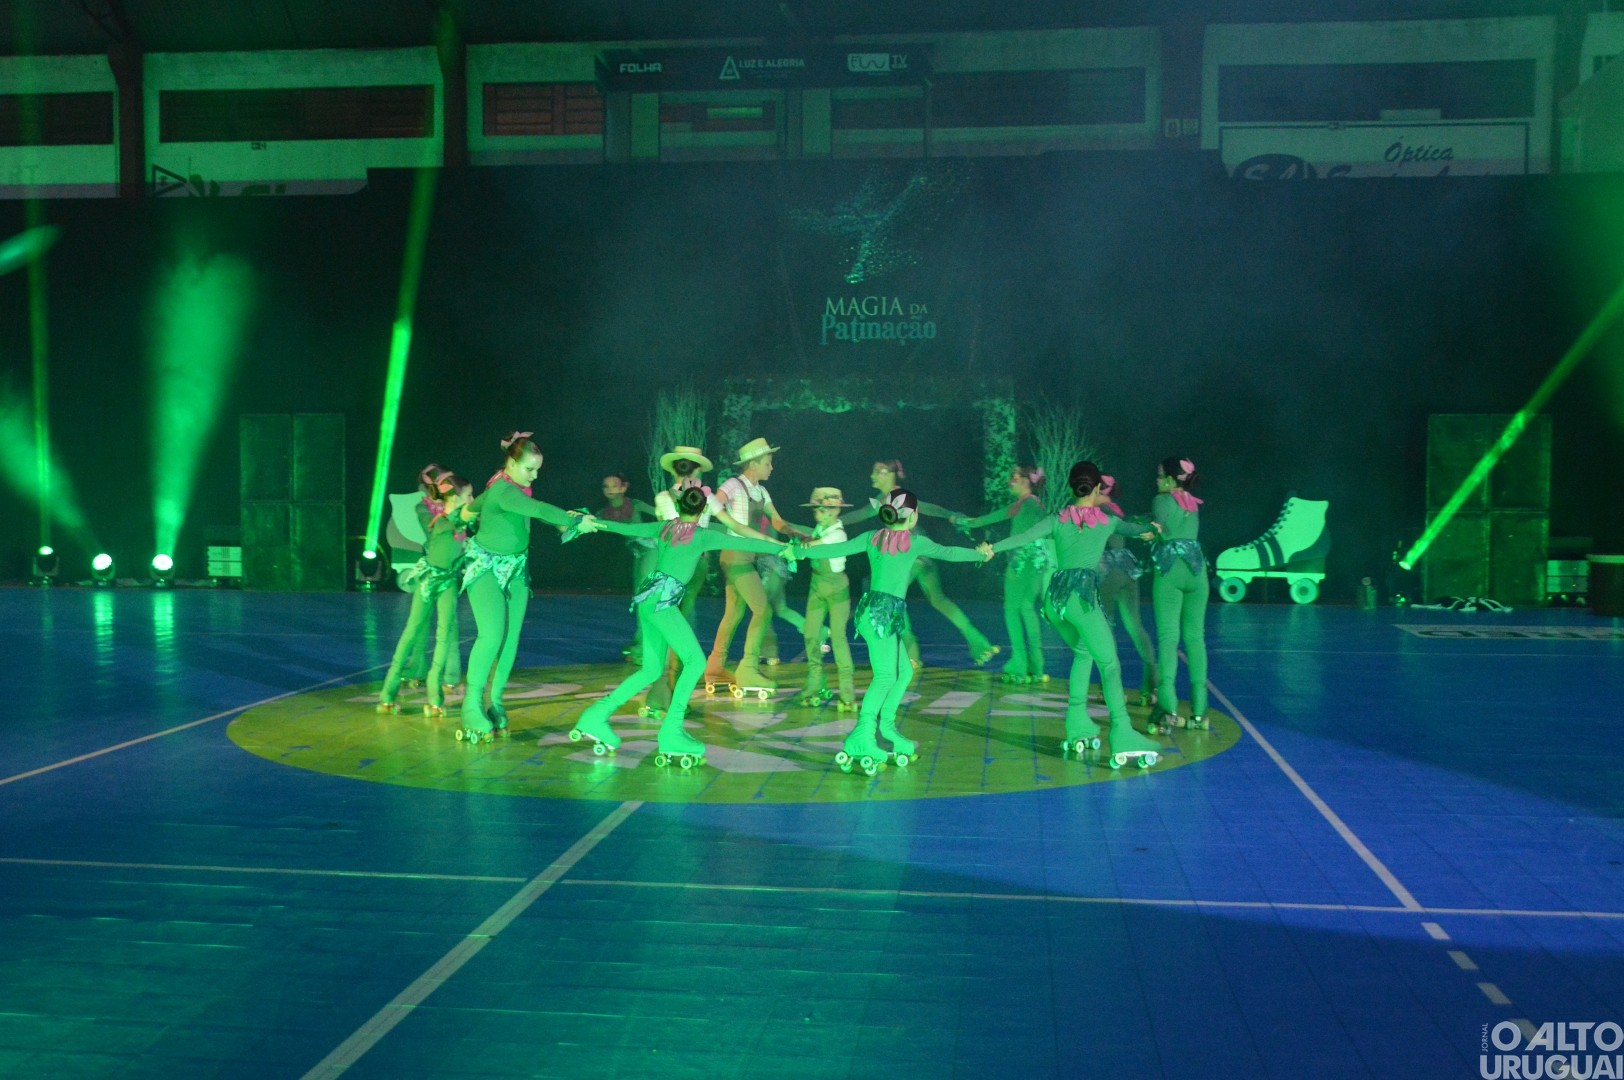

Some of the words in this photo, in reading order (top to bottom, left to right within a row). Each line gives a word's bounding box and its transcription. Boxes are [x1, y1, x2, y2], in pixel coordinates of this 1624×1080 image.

[738, 60, 757, 68] LUZ
[765, 58, 805, 67] ALEGRIA
[891, 54, 908, 65] TV
[619, 63, 662, 73] FOLHA
[825, 296, 904, 316] MAGIA
[909, 304, 928, 314] DA
[820, 314, 937, 346] Patinação
